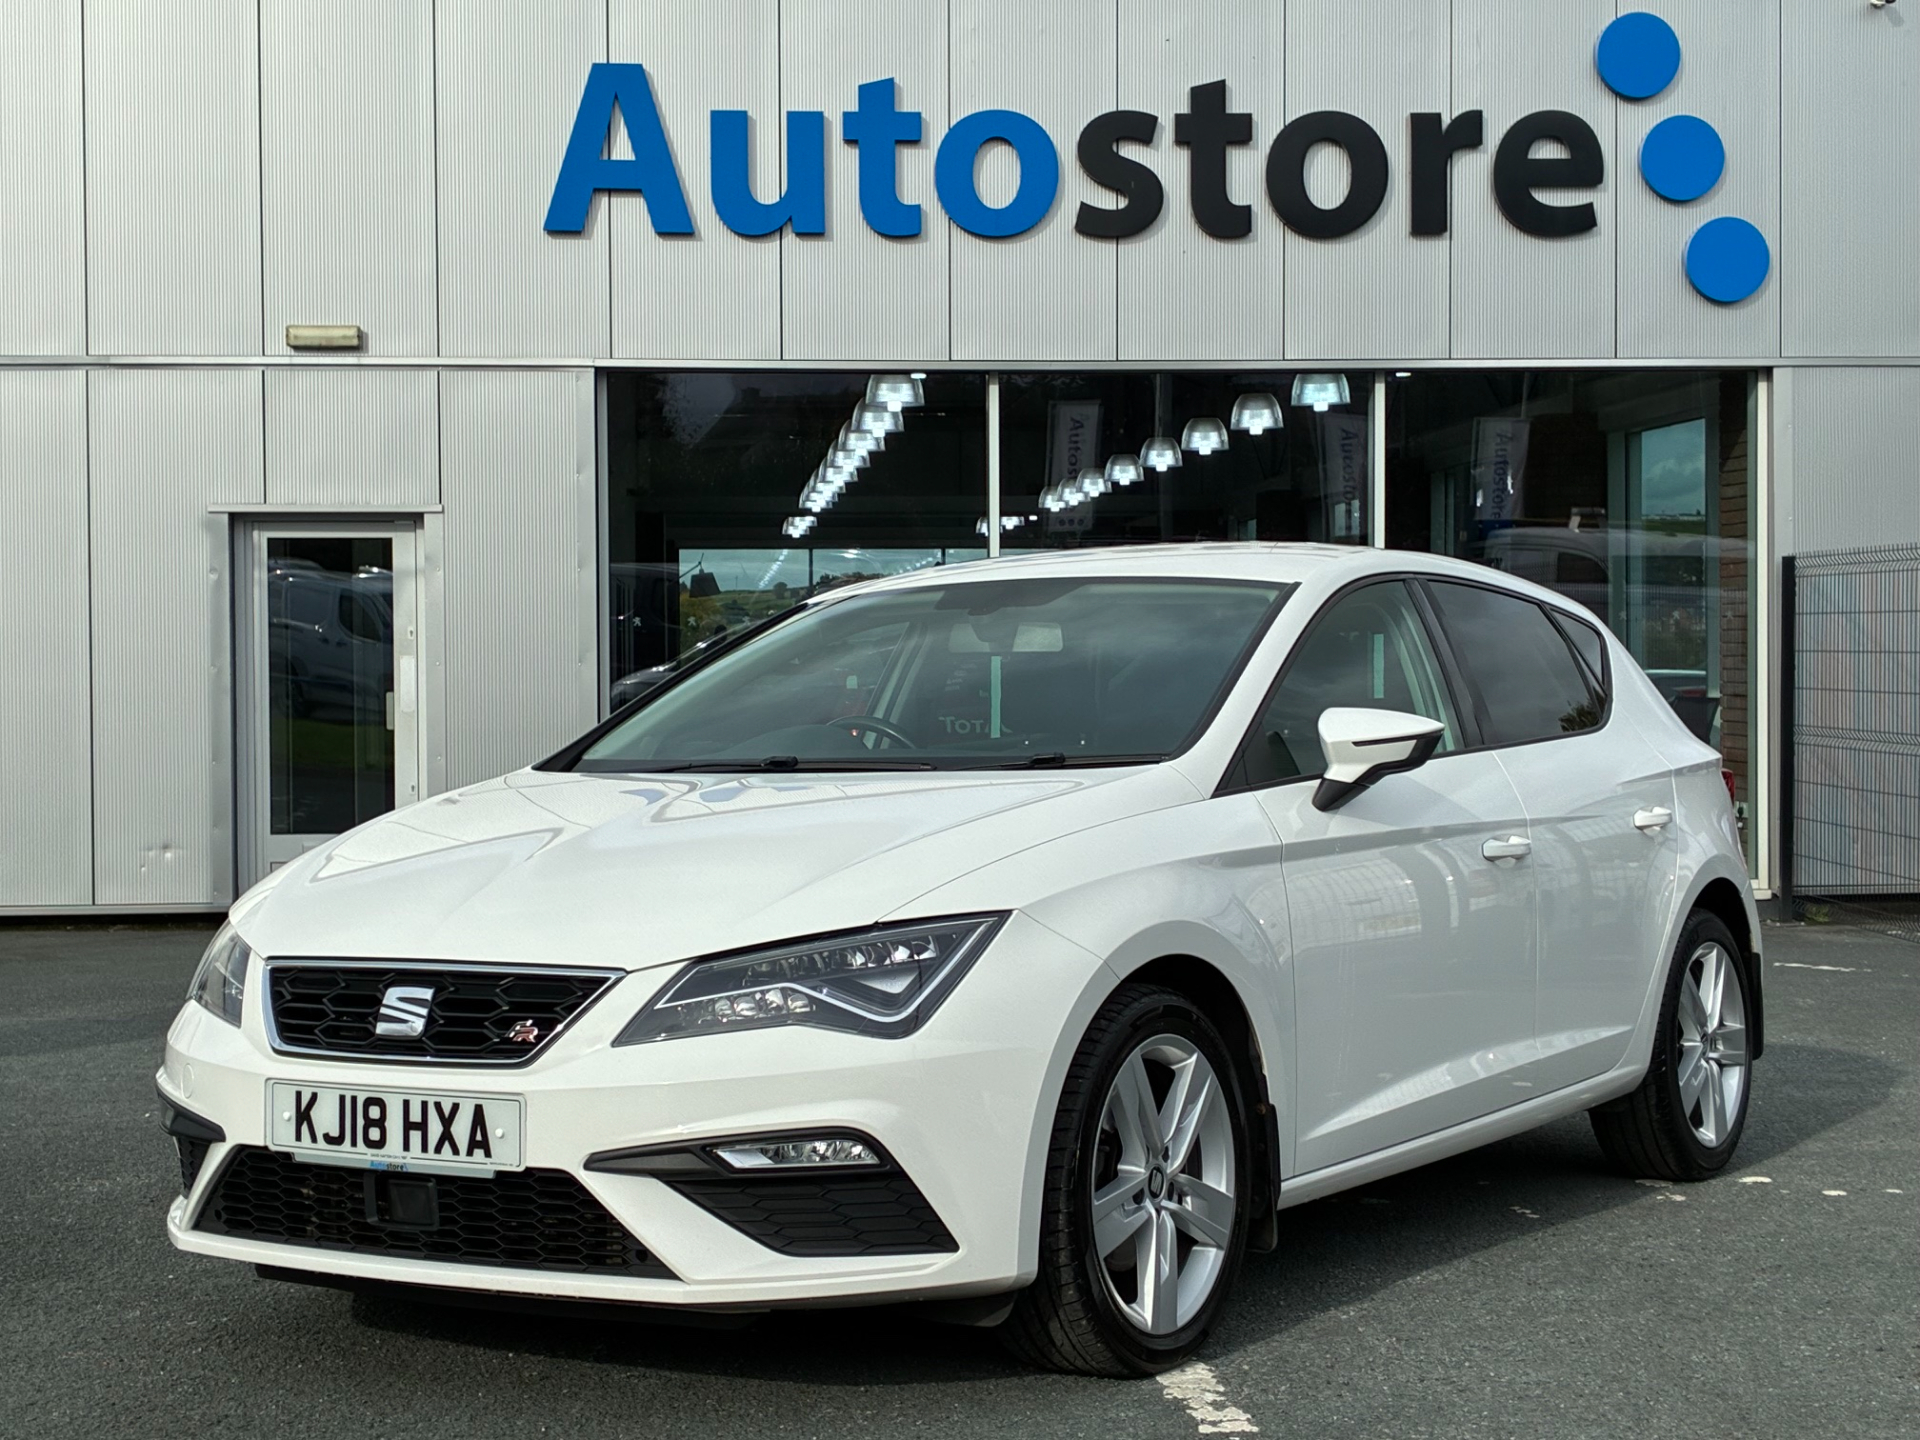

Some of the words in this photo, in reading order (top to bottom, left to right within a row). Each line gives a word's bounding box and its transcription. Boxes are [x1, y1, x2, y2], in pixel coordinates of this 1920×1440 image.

[543, 63, 1604, 239] Autostore
[294, 1090, 388, 1150] KJ18
[402, 1098, 493, 1159] HXA
